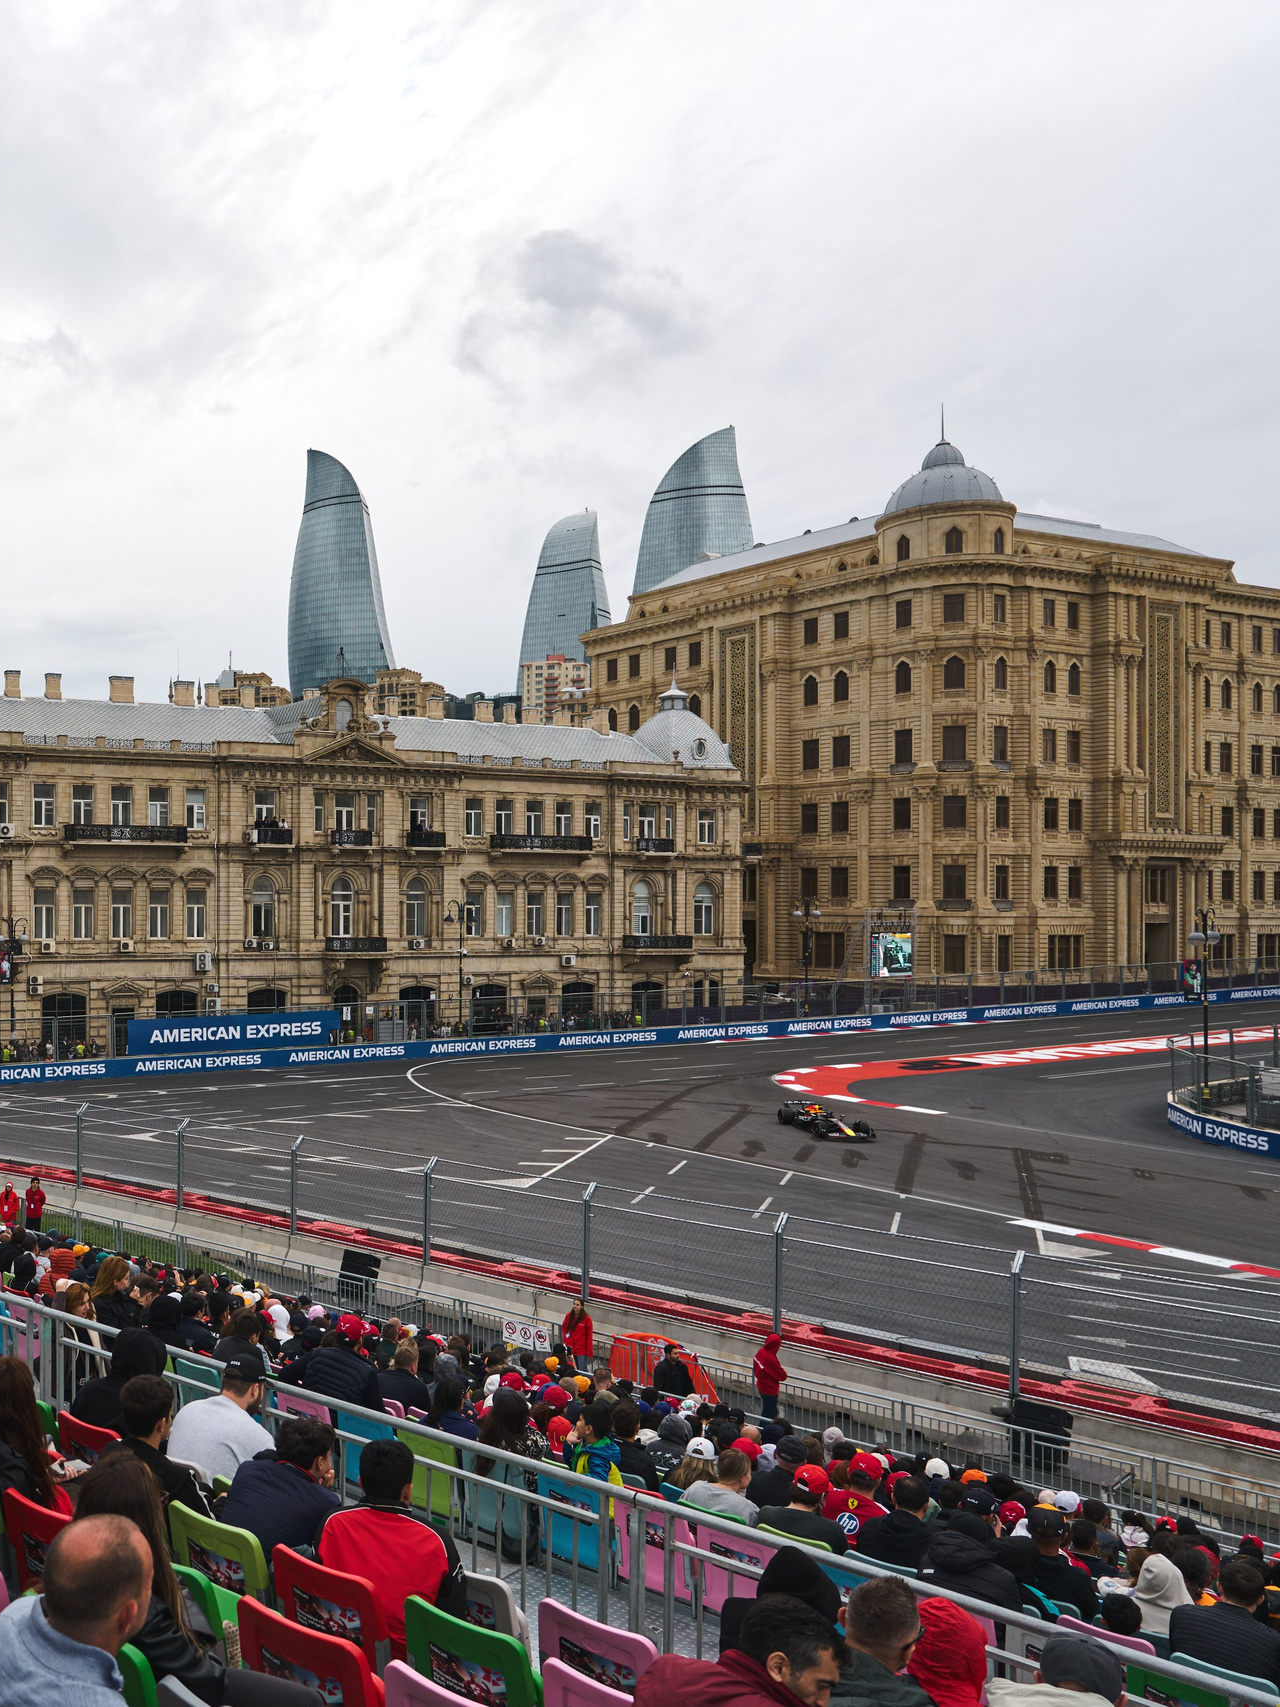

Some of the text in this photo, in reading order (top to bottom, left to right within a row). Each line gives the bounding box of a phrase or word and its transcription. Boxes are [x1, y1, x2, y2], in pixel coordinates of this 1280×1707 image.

[1230, 990, 1262, 999] AMERICAN
[983, 1004, 1057, 1018] AMERICAN EXPRESS
[1071, 998, 1140, 1011] AMERICAN EXPRESS
[787, 1018, 872, 1032] AMERICAN EXPRESS
[889, 1011, 967, 1025] AMERICAN EXPRESS
[150, 1021, 321, 1044] AMERICAN EXPRESS
[558, 1031, 657, 1046] AMERICAN EXPRESS
[677, 1025, 768, 1039] AMERICAN EXPRESS
[429, 1038, 536, 1054] AMERICAN EXPRESS
[288, 1045, 405, 1063] AMERICAN EXPRESS
[44, 1063, 106, 1078] EXPRESS
[135, 1054, 262, 1072] AMERICAN EXPRESS
[1167, 1107, 1269, 1151] AMERICAN EXPRESS
[840, 1512, 857, 1534] hp
